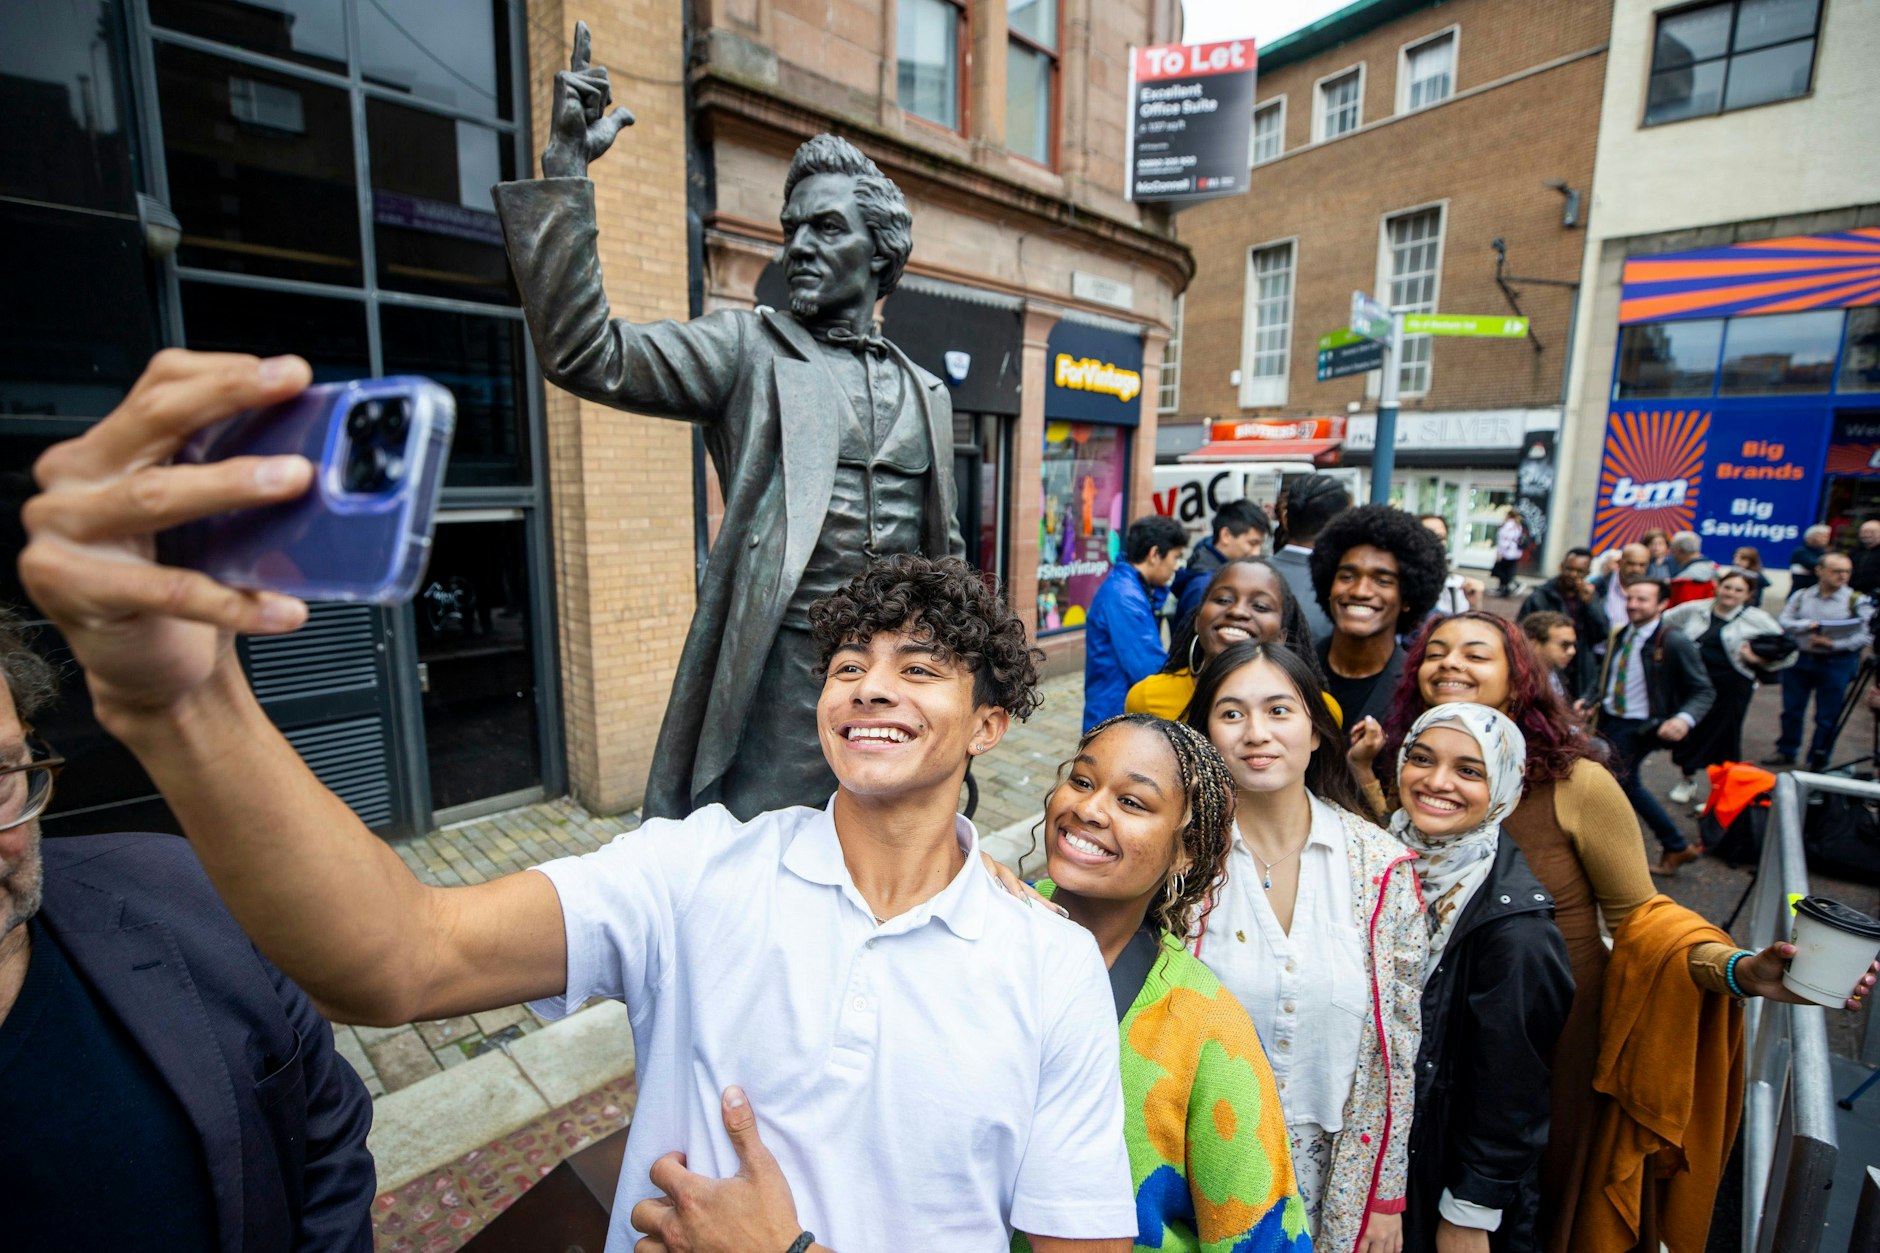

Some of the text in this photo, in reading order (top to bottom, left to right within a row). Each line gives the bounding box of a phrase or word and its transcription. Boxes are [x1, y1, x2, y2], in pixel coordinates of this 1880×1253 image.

[1146, 41, 1245, 74] To Let
[1140, 83, 1203, 101] Excellent
[1139, 98, 1218, 118] Office Suite
[1057, 357, 1140, 399] ForVintage
[1417, 417, 1513, 442] SILVER
[1741, 441, 1784, 461] Big
[1716, 463, 1804, 480] Brands
[1731, 498, 1773, 519] Big
[1701, 519, 1798, 542] Savings
